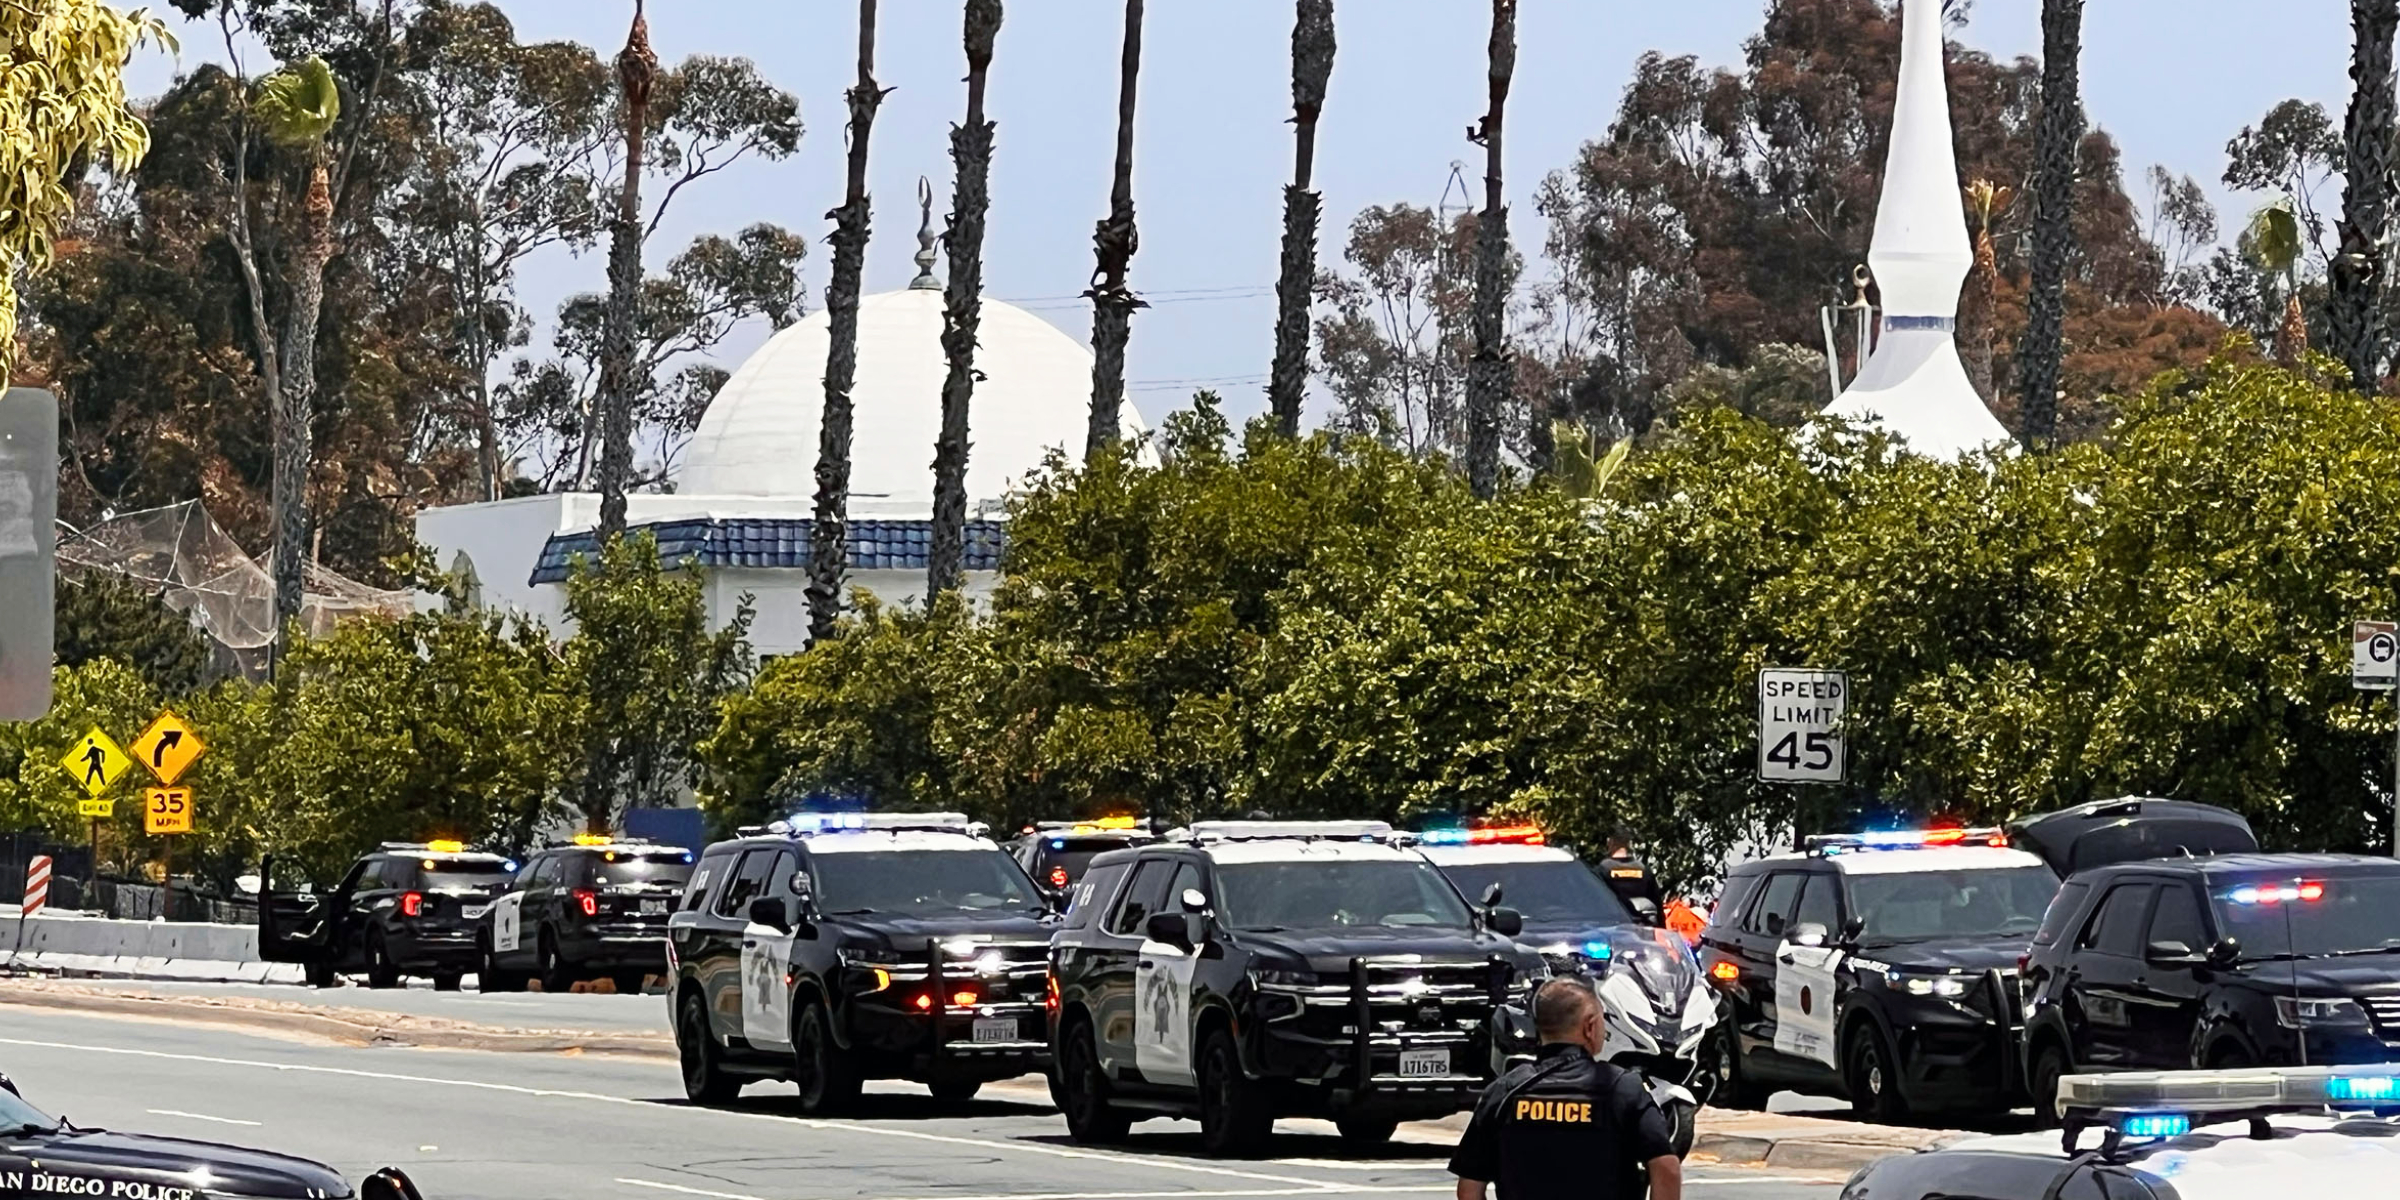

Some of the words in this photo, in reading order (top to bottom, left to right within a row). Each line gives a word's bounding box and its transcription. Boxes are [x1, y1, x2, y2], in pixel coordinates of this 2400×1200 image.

[1766, 681, 1842, 699] SPEED
[1773, 706, 1834, 724] LIMIT
[1766, 731, 1834, 770] 45
[152, 793, 184, 814] 35
[1516, 1100, 1592, 1123] POLICE
[31, 1173, 106, 1196] DIEGO
[111, 1181, 194, 1200] POLICE
